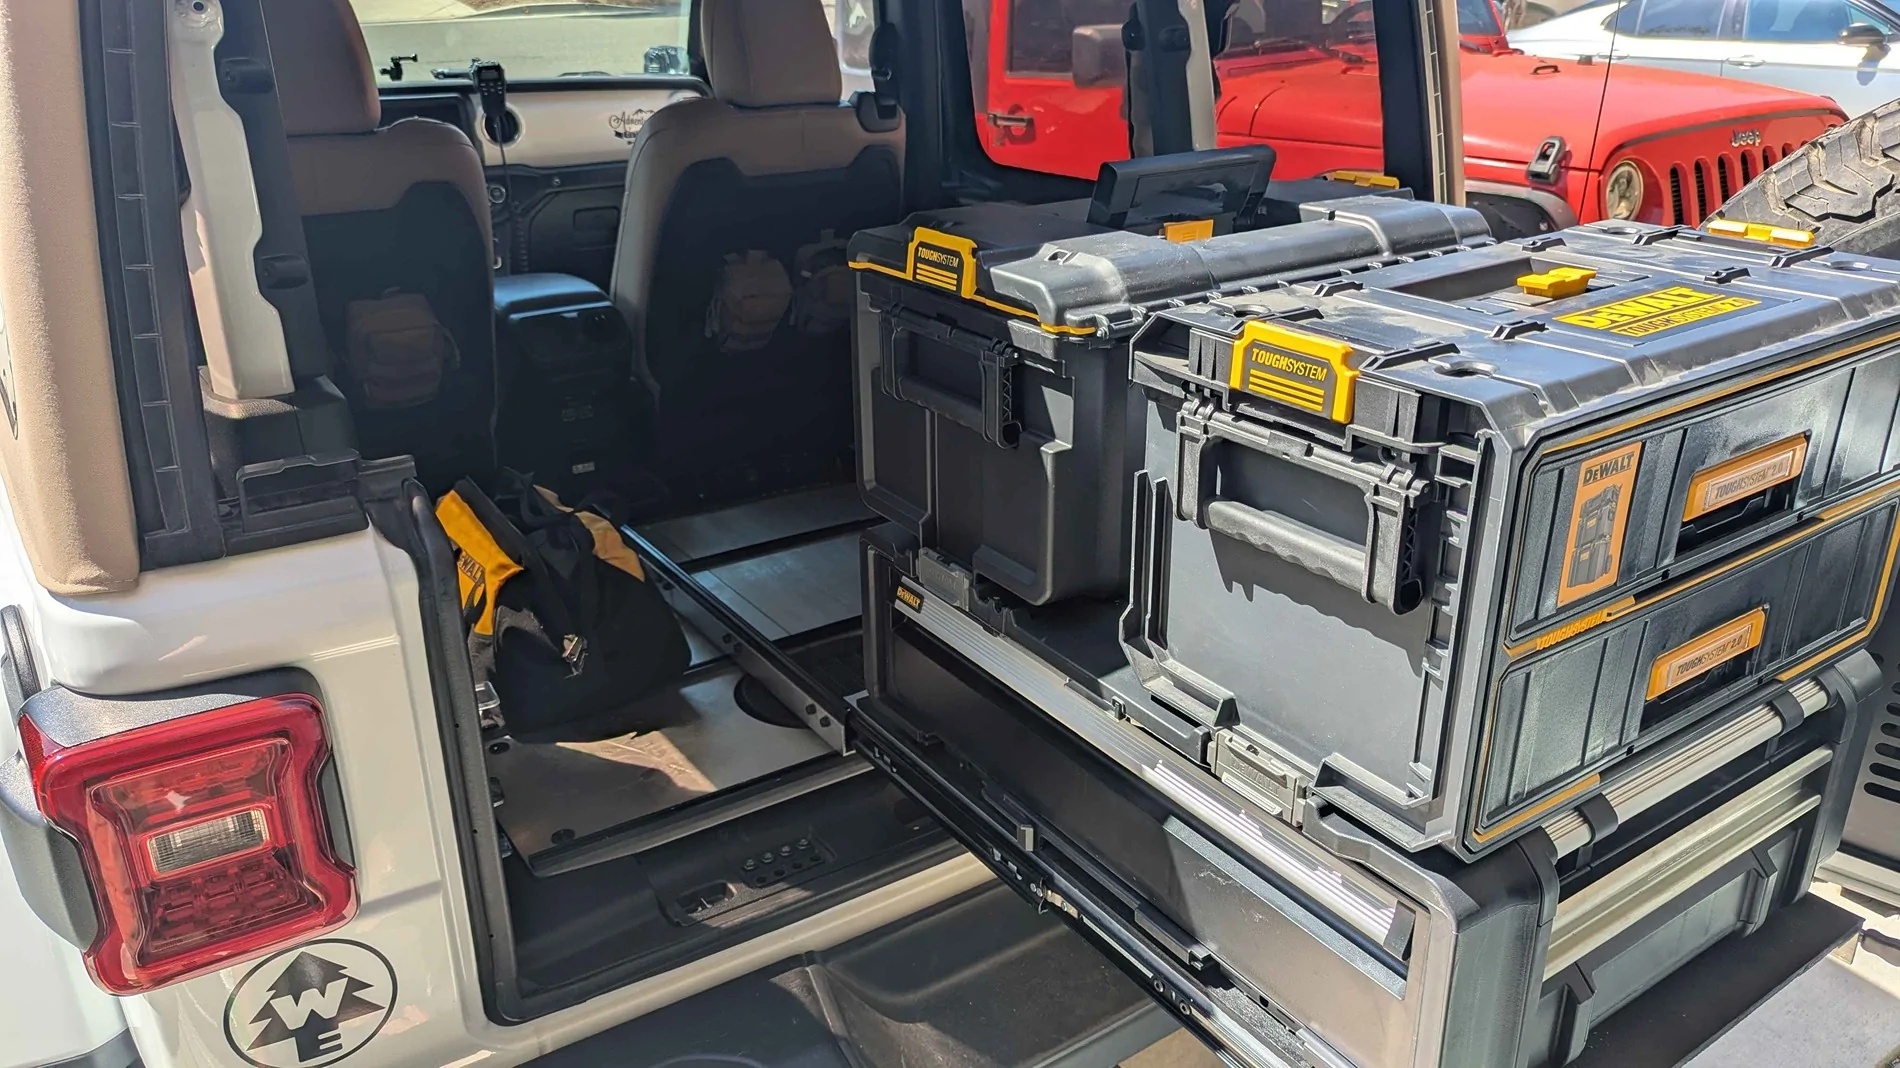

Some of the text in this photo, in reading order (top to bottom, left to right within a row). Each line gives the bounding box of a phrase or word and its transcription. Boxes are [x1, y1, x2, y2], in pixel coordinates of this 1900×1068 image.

[1731, 129, 1761, 148] Jeep
[917, 246, 959, 268] TOUGHSYSTEM
[1618, 304, 1721, 337] TOUGHSYSTEM
[1251, 347, 1328, 382] TOUGHSYSTEM
[1715, 463, 1784, 499] TOUGHSYSTEM 2.0
[1676, 635, 1743, 676] TOUGHSYSTEM 2.0
